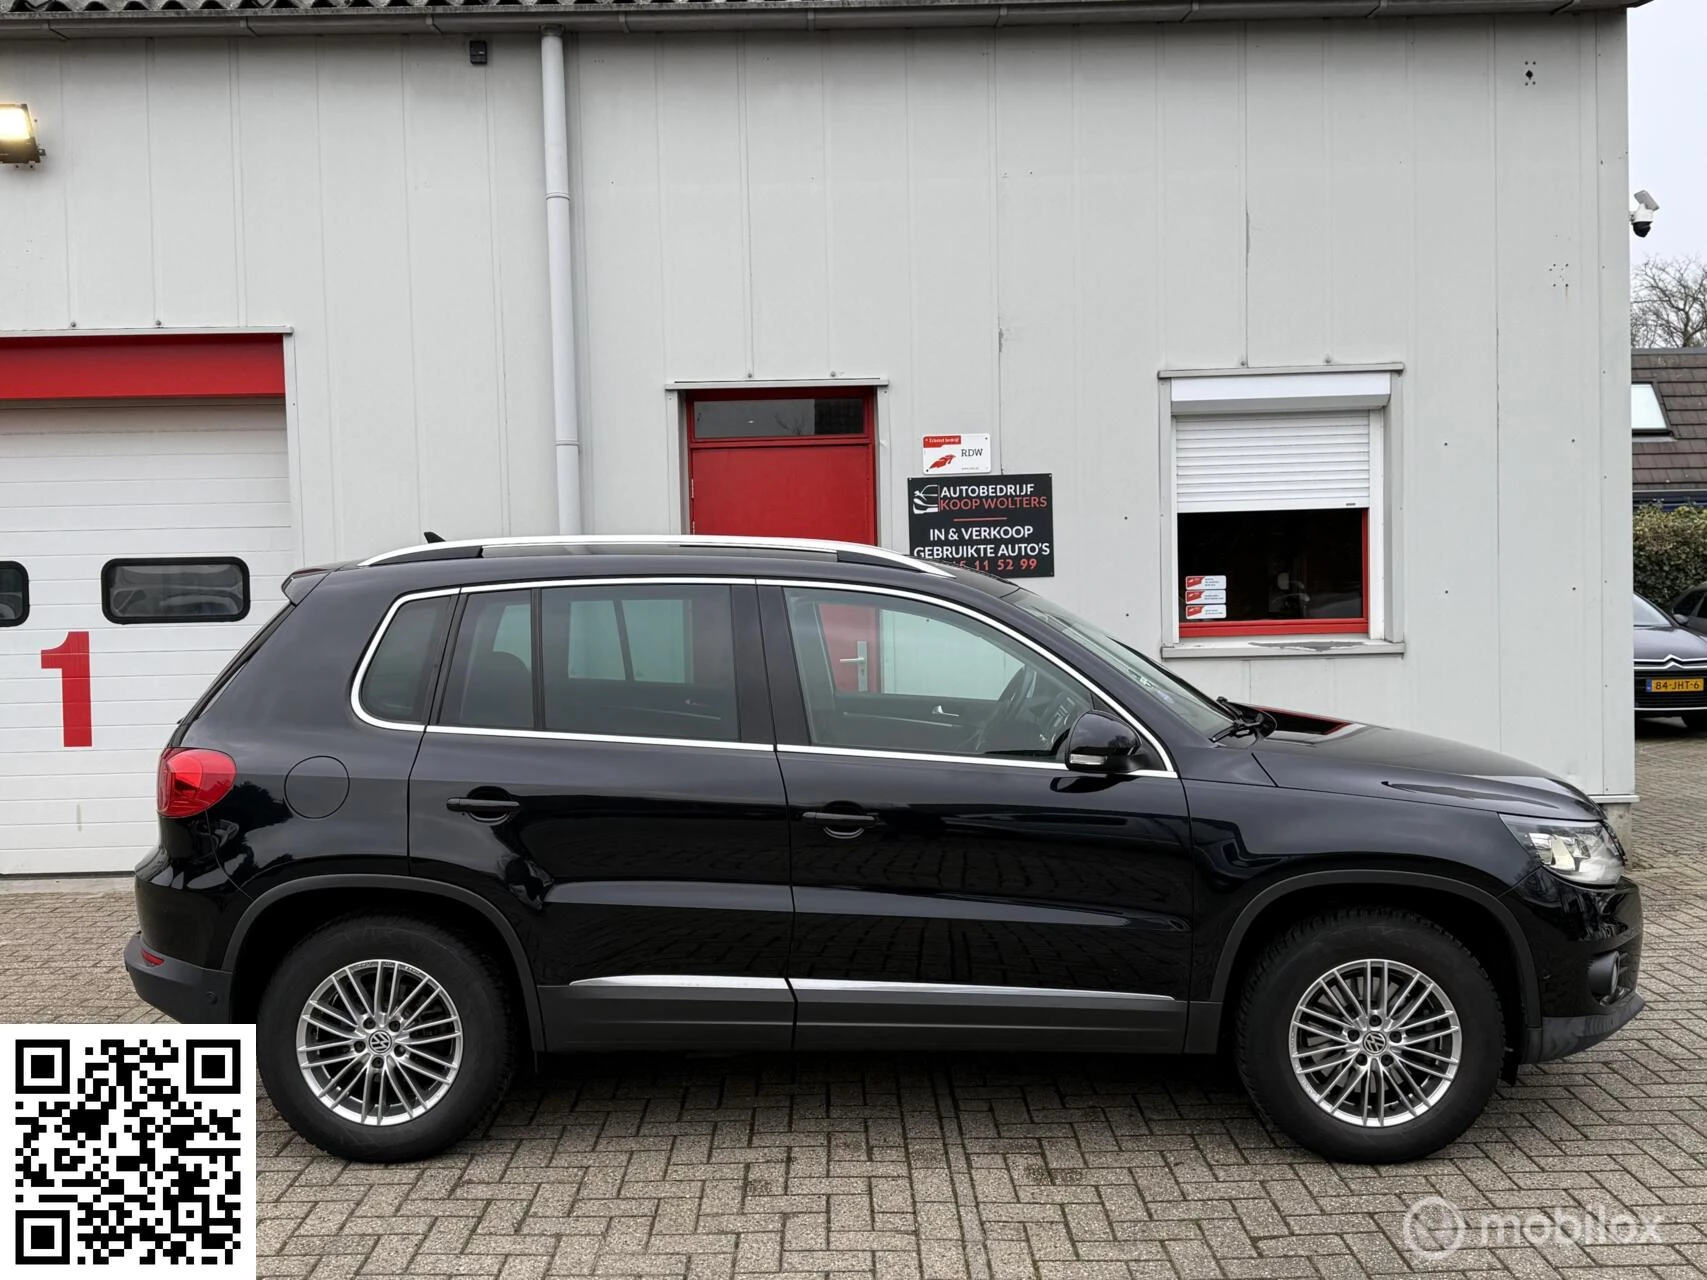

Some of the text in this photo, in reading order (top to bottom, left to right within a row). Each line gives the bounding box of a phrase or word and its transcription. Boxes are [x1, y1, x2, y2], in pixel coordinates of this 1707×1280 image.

[961, 448, 983, 457] RDW
[940, 484, 1034, 498] AUTOBEDRIJF
[940, 496, 1047, 511] KOOP WOLTERS
[930, 526, 1033, 541] IN & VERKOOP
[914, 543, 1050, 559] GEBRUIKTE AUTO'S
[997, 560, 1014, 570] 52
[1020, 559, 1037, 570] 99
[41, 631, 92, 747] 1
[1655, 681, 1700, 690] 84-JHT-6
